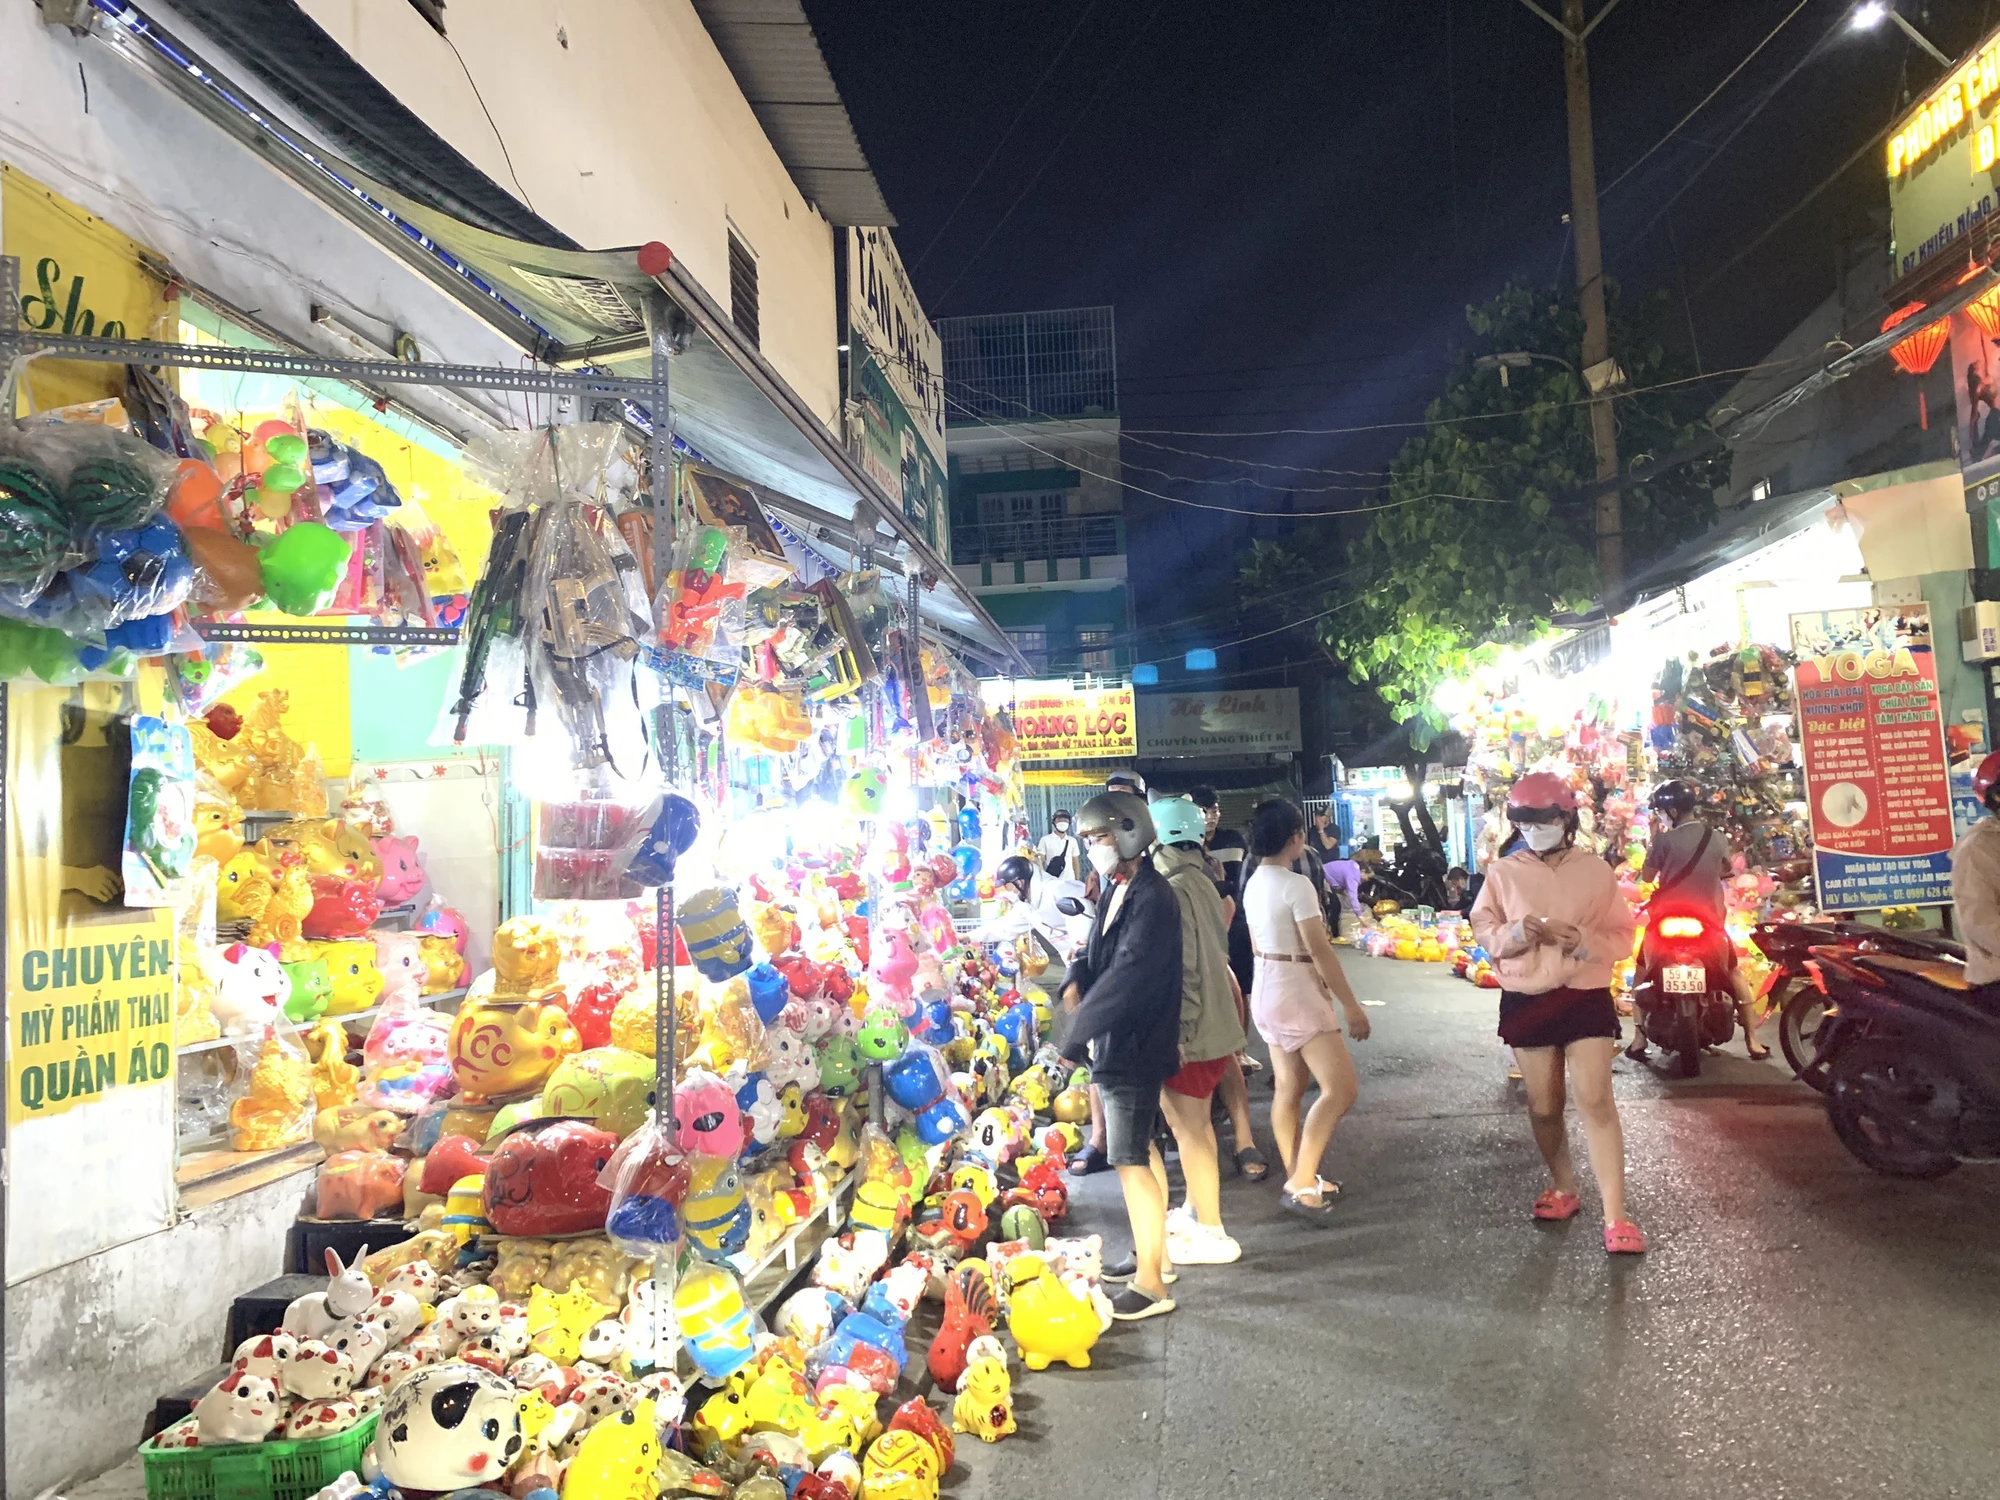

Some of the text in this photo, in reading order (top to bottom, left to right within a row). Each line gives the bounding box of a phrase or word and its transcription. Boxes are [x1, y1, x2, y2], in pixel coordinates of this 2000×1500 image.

[1965, 38, 2000, 111] CH
[1812, 647, 1920, 683] YOGA
[1213, 694, 1268, 715] Linh
[1084, 709, 1127, 739] LỘC
[1806, 721, 1835, 735] Đặc
[1072, 738, 1097, 748] TRANG
[1147, 729, 1292, 747] CHUYÊN HÀNG THIẾT KẾ
[22, 934, 169, 992] CHUYÊN
[1669, 969, 1681, 980] 59
[1665, 980, 1703, 992] 353.50
[21, 987, 169, 1048] MỸ PHẨM THÁI
[20, 1040, 170, 1111] QUẦN ÁO
